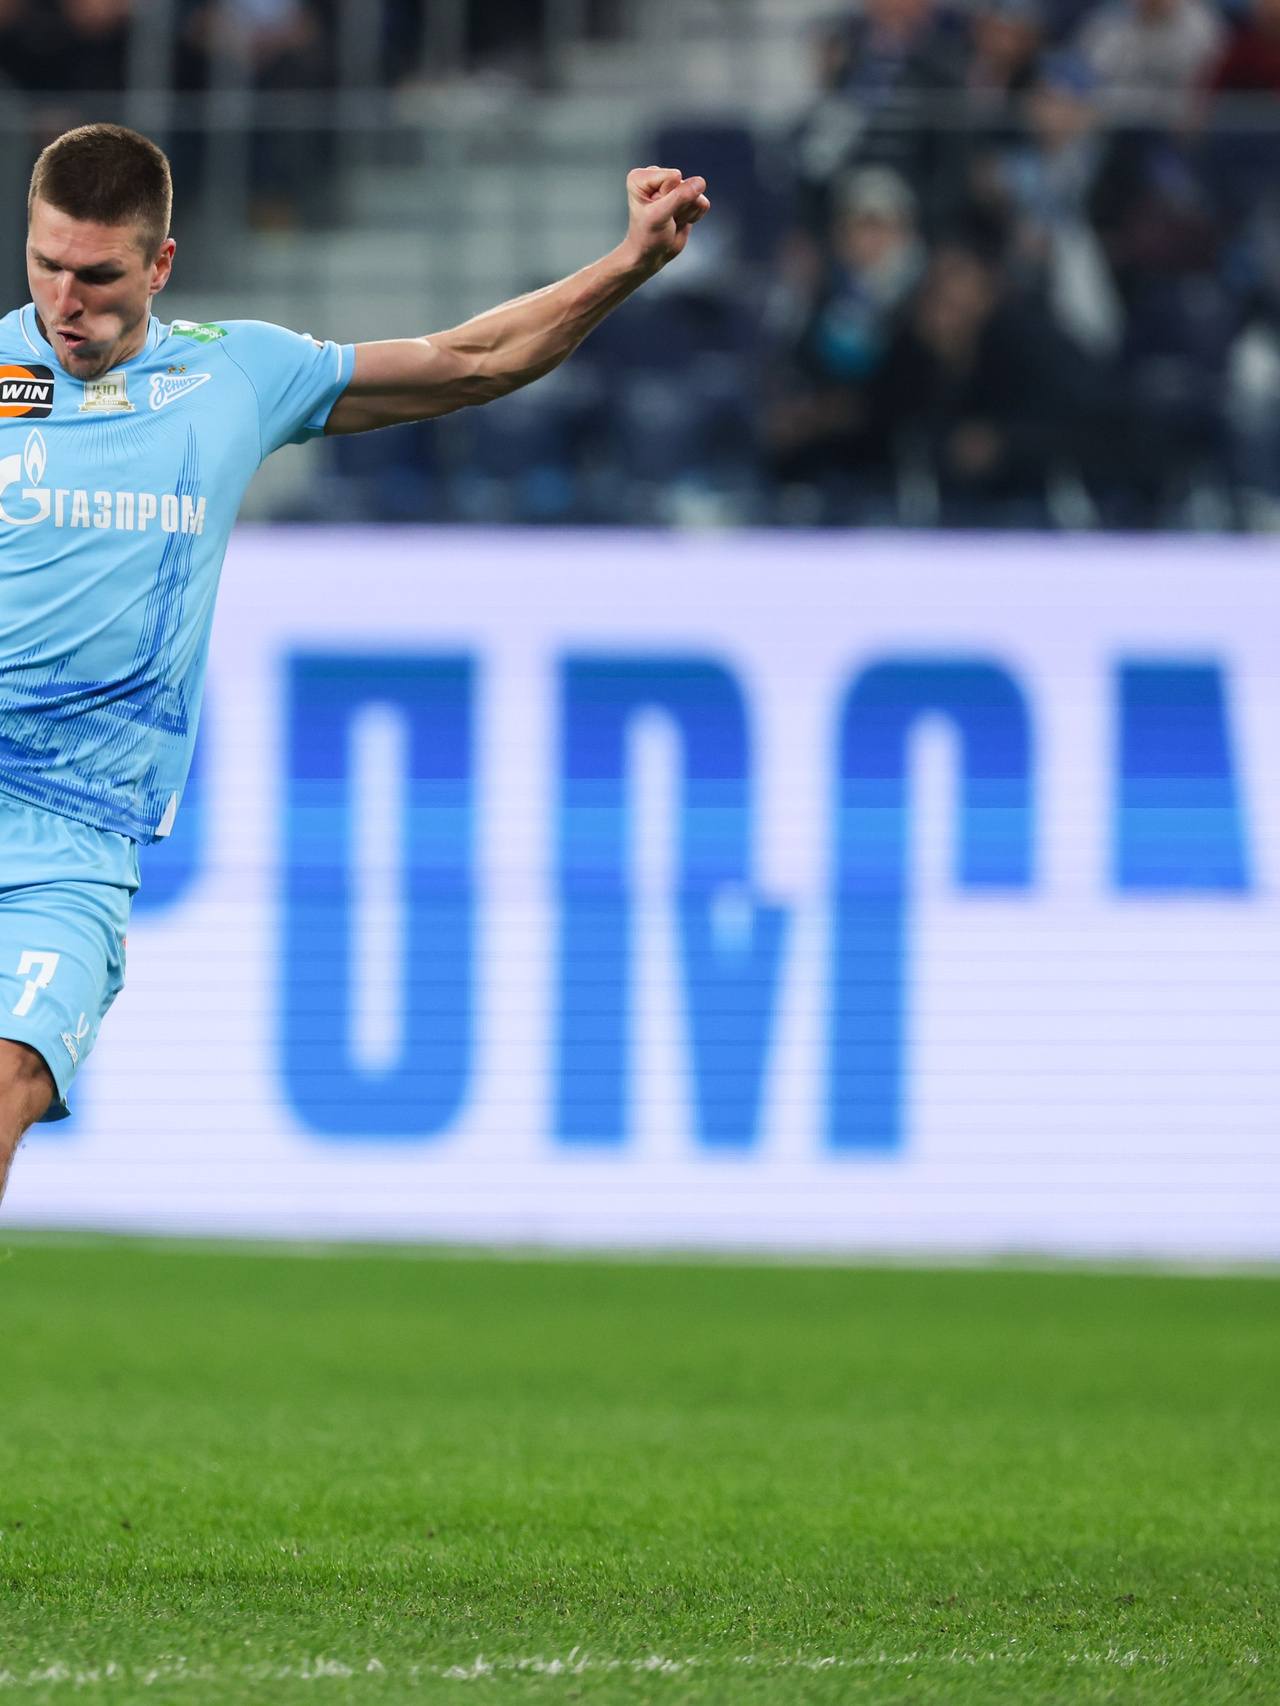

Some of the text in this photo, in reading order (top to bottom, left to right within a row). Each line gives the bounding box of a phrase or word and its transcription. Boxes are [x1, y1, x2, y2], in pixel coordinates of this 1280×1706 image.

[1, 384, 49, 400] WIN
[54, 489, 206, 536] ГАЗПРОМ
[12, 951, 60, 1016] 7
